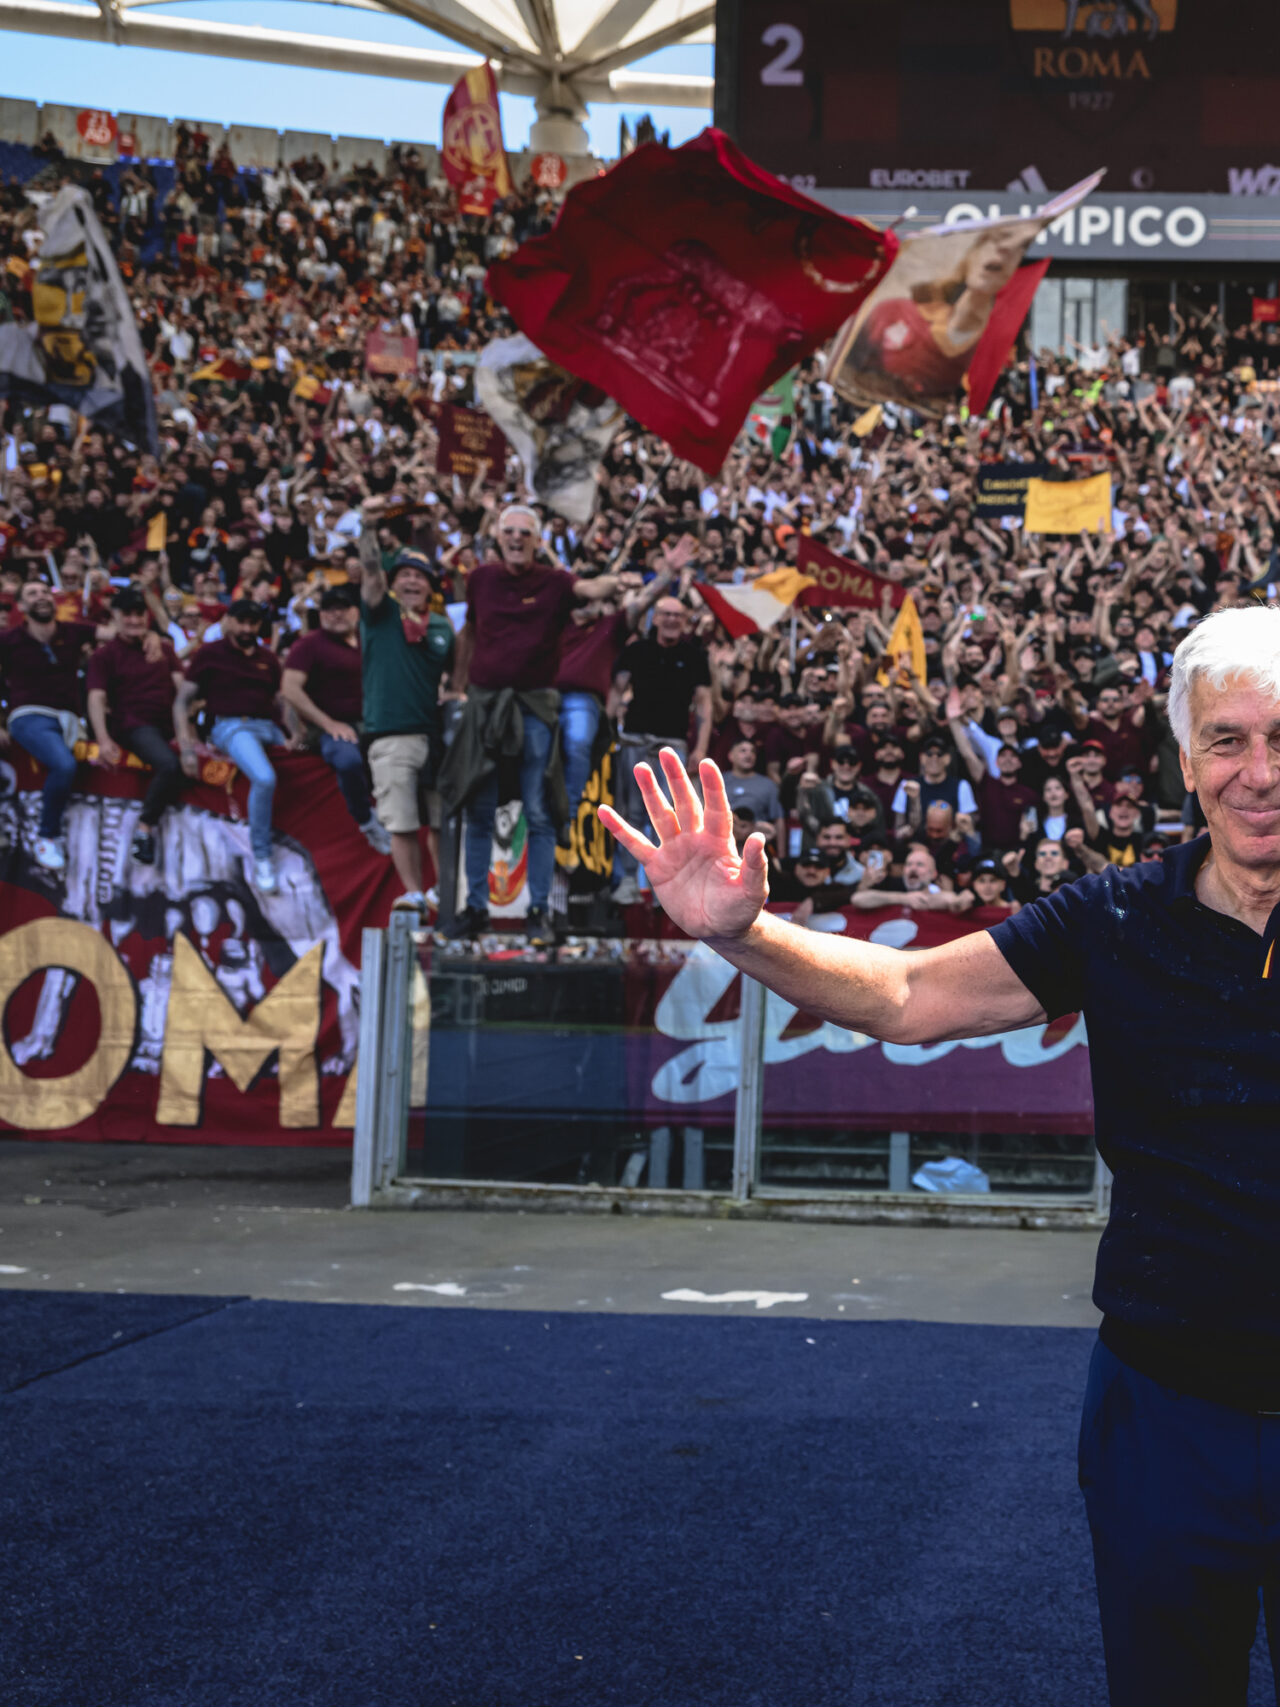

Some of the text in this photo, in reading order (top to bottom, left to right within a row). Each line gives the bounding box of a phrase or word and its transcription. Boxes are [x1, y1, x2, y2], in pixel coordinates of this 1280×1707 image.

[761, 23, 803, 86] 2
[1033, 47, 1150, 79] ROMA
[870, 169, 971, 189] EUROBET
[945, 203, 1207, 248] MPICO
[804, 562, 875, 599] ROMA
